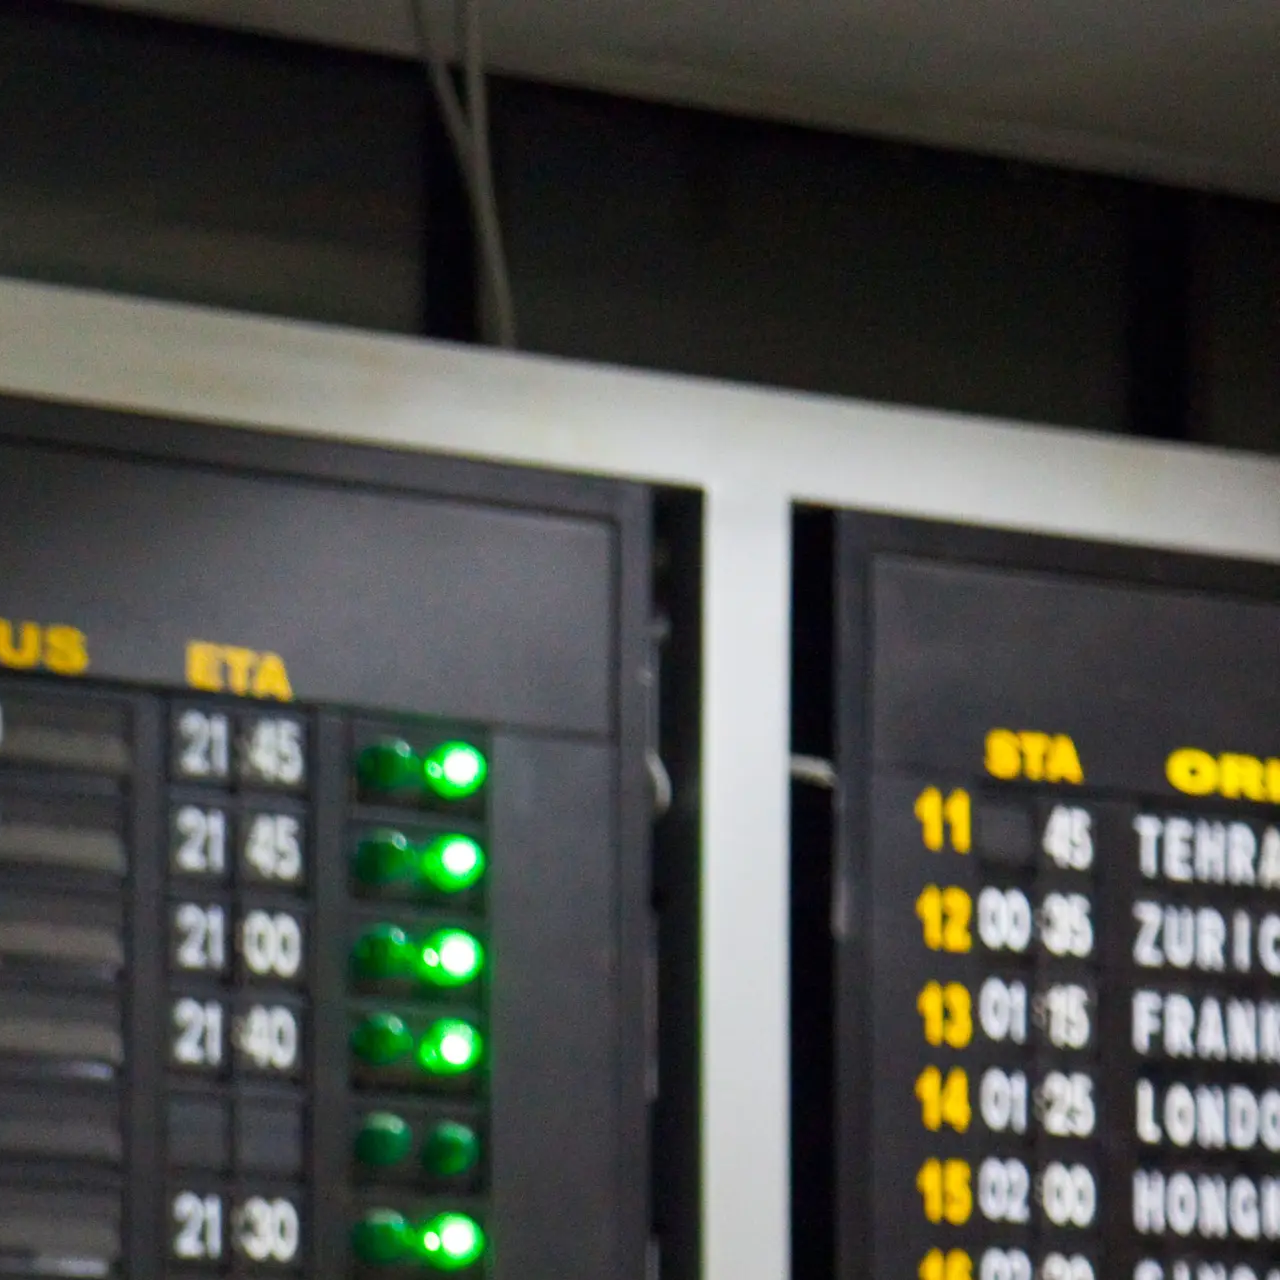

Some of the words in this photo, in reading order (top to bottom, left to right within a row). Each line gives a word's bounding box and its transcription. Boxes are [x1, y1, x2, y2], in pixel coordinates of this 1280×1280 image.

[186, 641, 292, 699] ETA
[182, 712, 227, 773] 21
[249, 720, 302, 782] 45
[986, 731, 1082, 782] STA
[179, 808, 224, 869] 21
[248, 816, 300, 878] 45
[916, 789, 970, 851] 11
[1045, 808, 1092, 868] 45
[179, 905, 223, 966] 21
[244, 912, 300, 975] 00
[917, 888, 970, 951] 12
[176, 1000, 221, 1062] 21
[919, 984, 971, 1047] 13
[917, 1069, 970, 1130] 14
[919, 1161, 971, 1223] 15
[176, 1194, 221, 1256] 21
